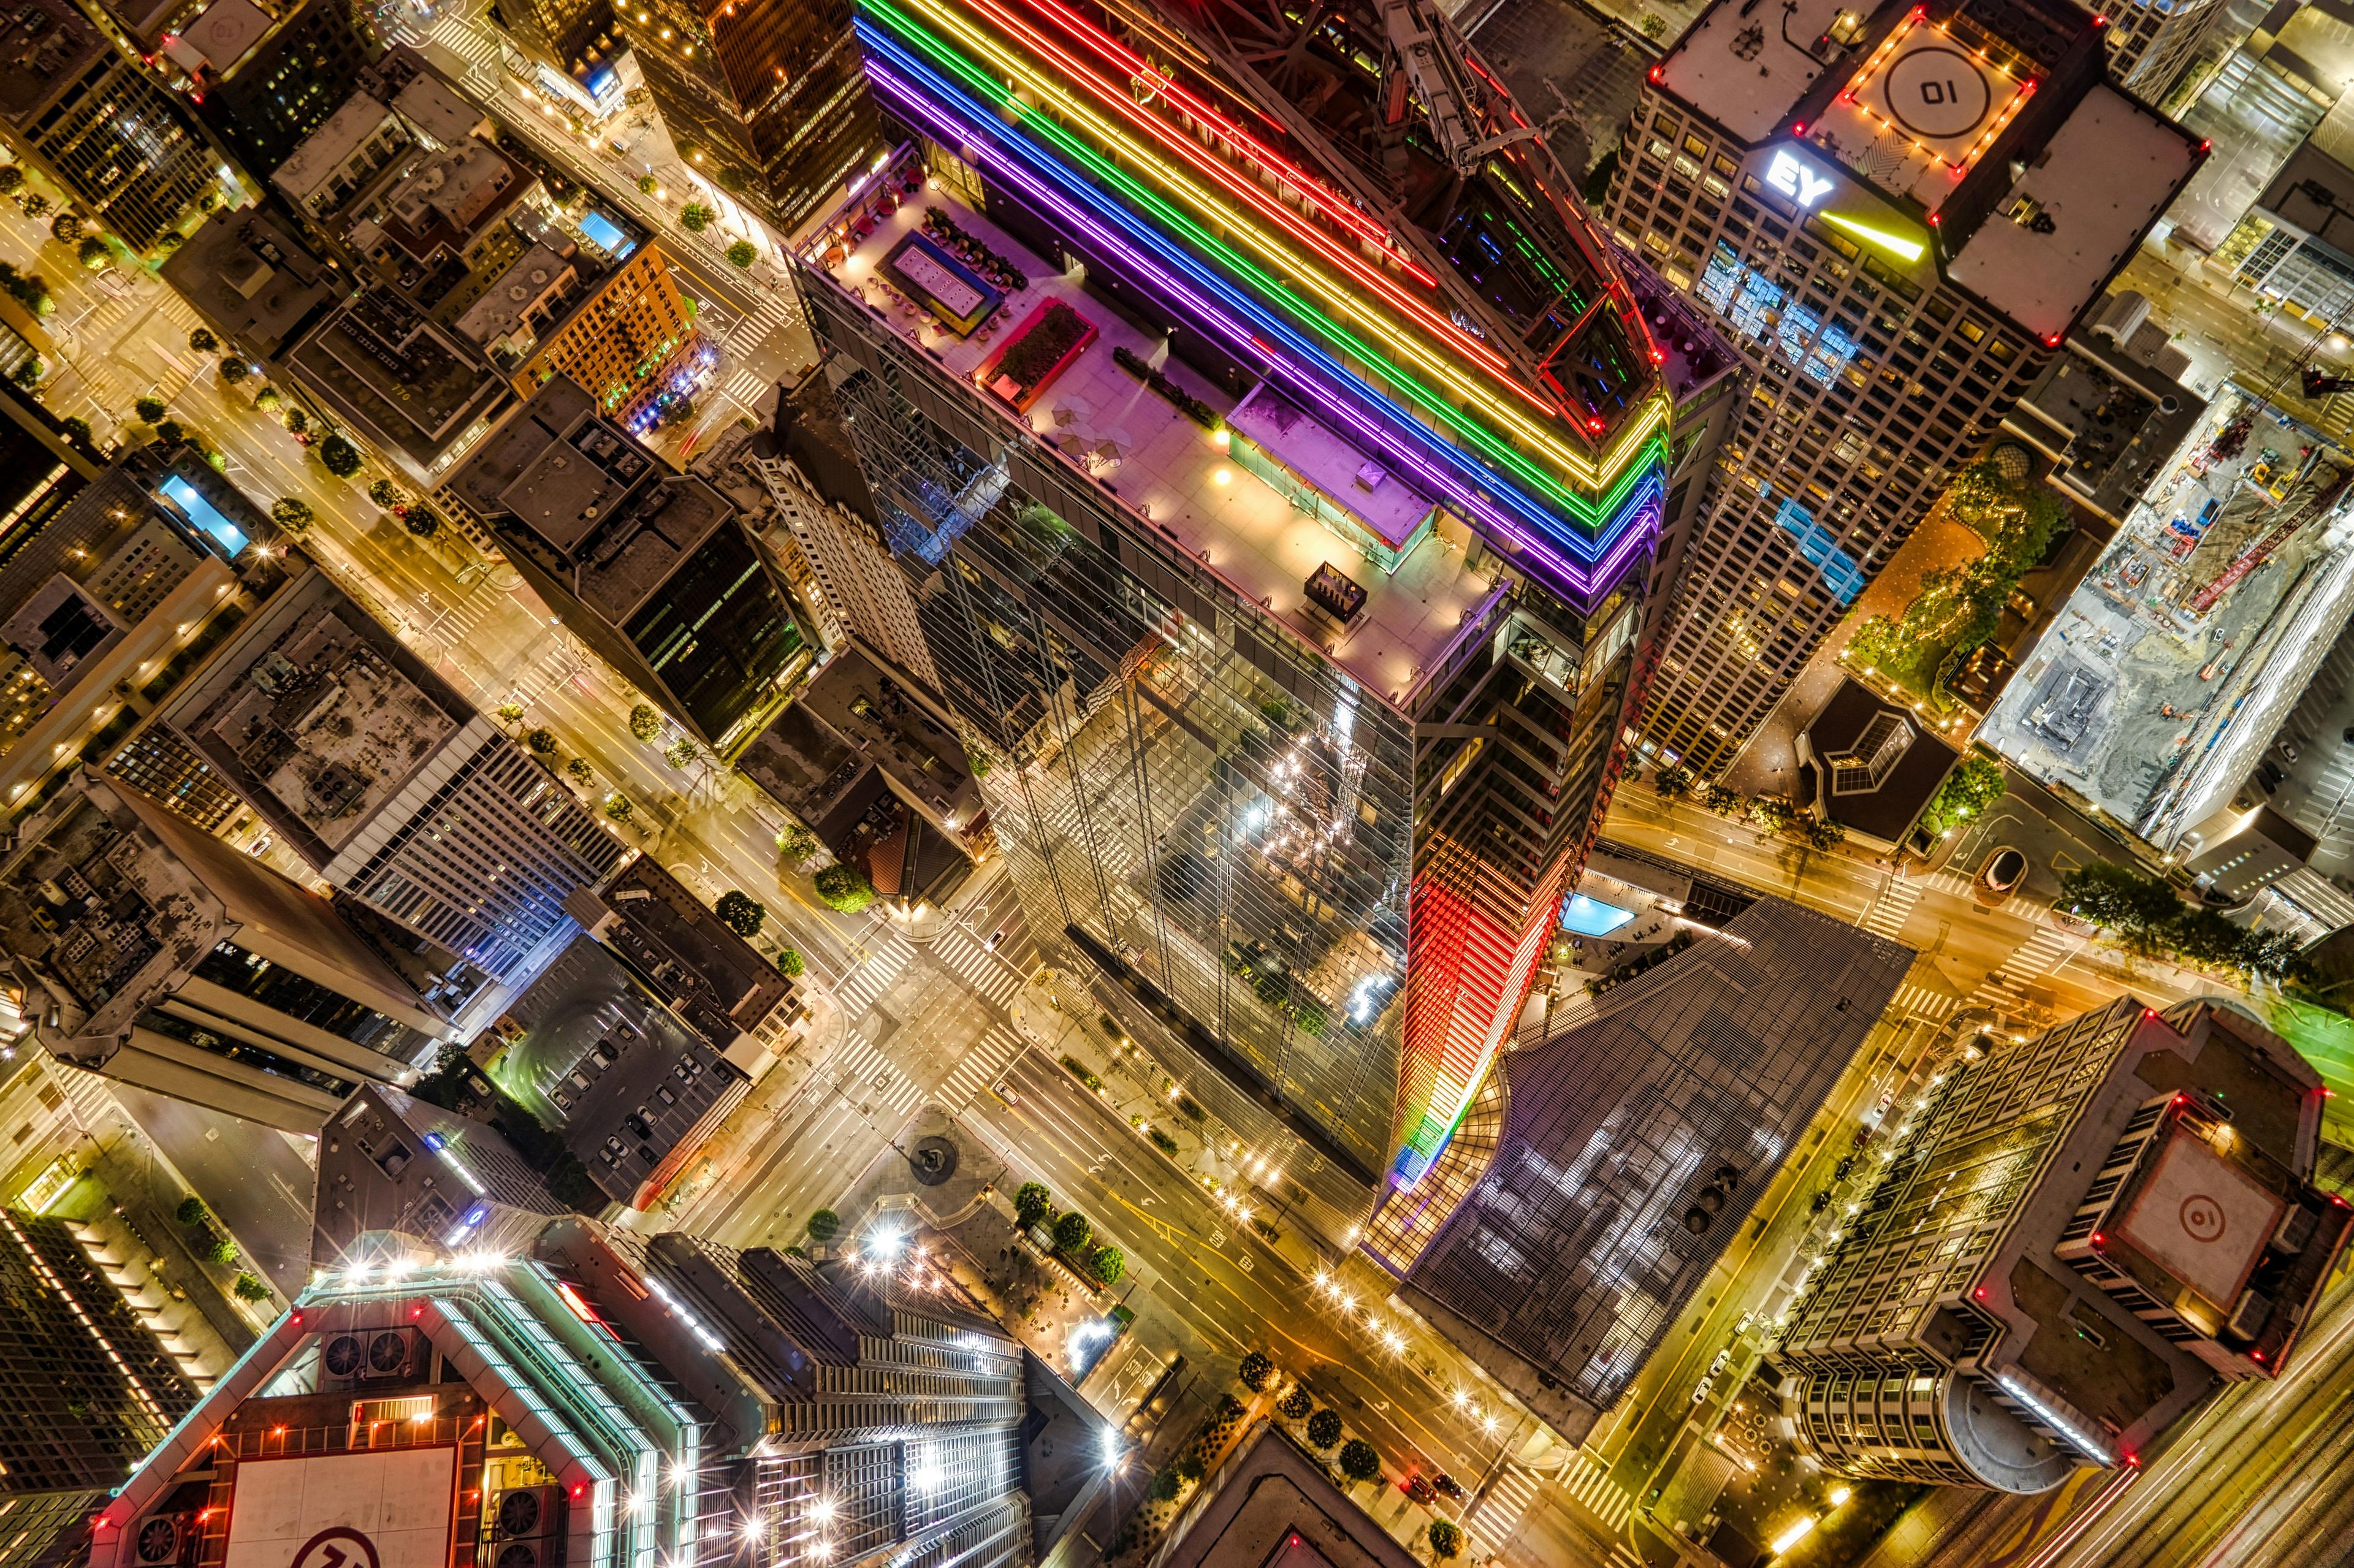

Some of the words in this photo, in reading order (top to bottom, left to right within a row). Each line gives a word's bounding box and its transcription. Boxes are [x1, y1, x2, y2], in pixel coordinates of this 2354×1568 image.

[1766, 150, 1834, 207] EY
[391, 383, 411, 401] 770
[1208, 1230, 1227, 1249] CLEAR
[1238, 1255, 1255, 1273] KEEP
[1126, 1358, 1143, 1378] STOP
[1138, 1370, 1156, 1389] STOP
